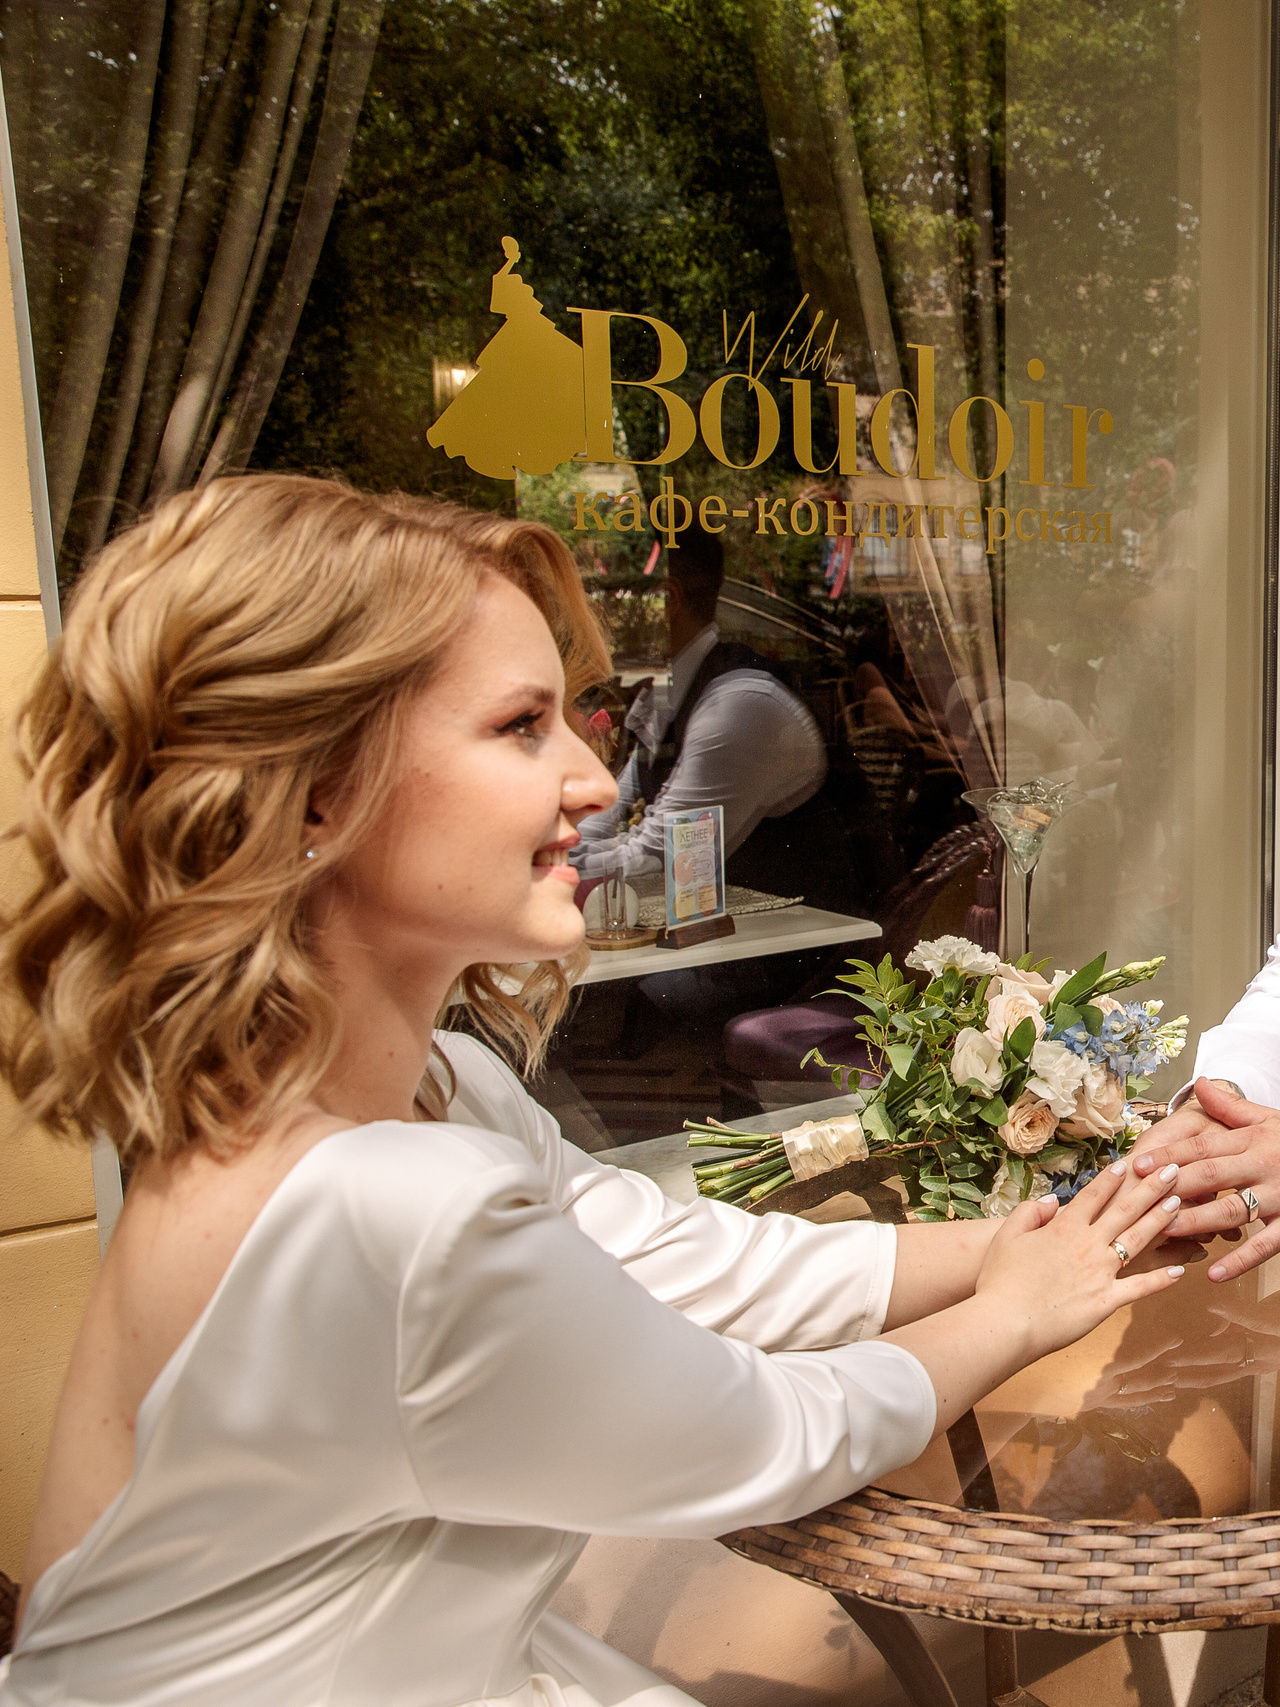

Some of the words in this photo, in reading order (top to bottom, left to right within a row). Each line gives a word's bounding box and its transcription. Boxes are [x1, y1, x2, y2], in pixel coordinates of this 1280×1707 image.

[722, 293, 842, 391] Wild
[566, 306, 1114, 489] Boudoir
[573, 476, 1114, 555] кафе-кондитерская
